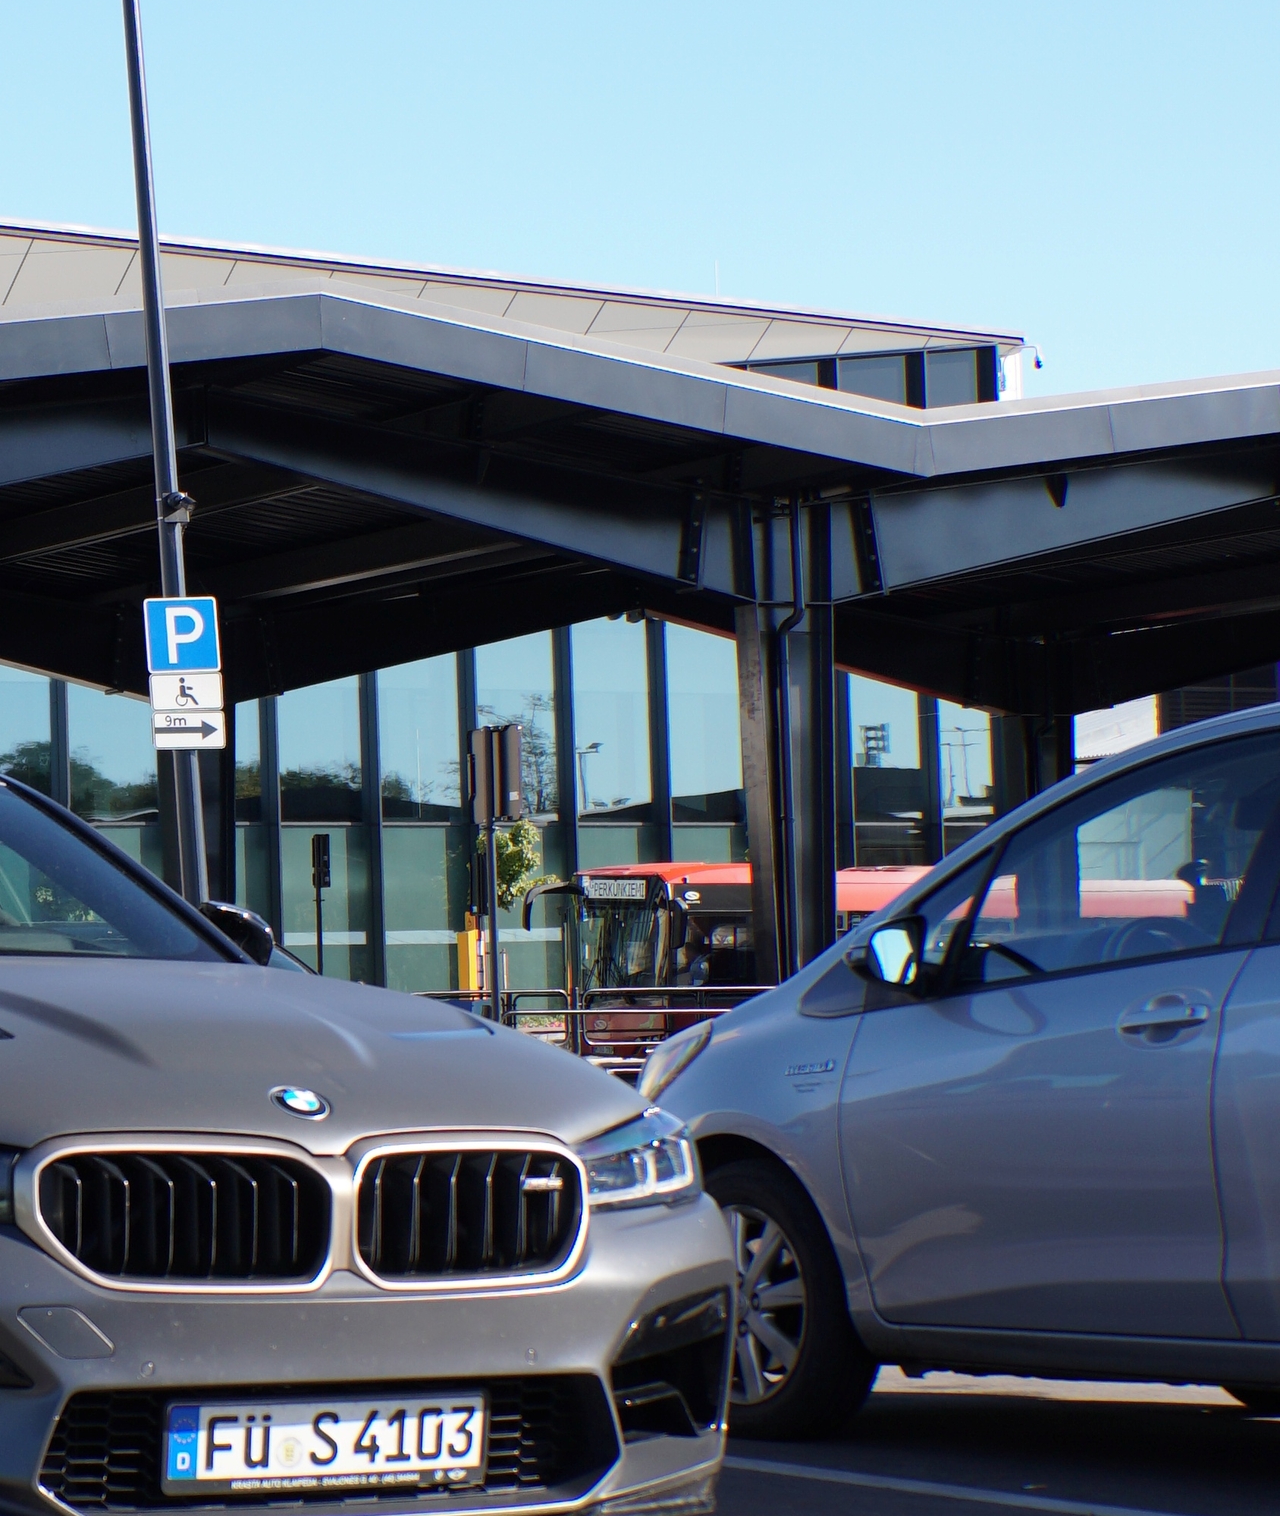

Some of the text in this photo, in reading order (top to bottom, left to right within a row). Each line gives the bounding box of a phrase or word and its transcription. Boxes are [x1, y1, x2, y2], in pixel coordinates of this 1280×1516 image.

[165, 606, 204, 665] P
[164, 715, 187, 727] 9m
[177, 1451, 191, 1471] D
[205, 1414, 271, 1472] FÜ
